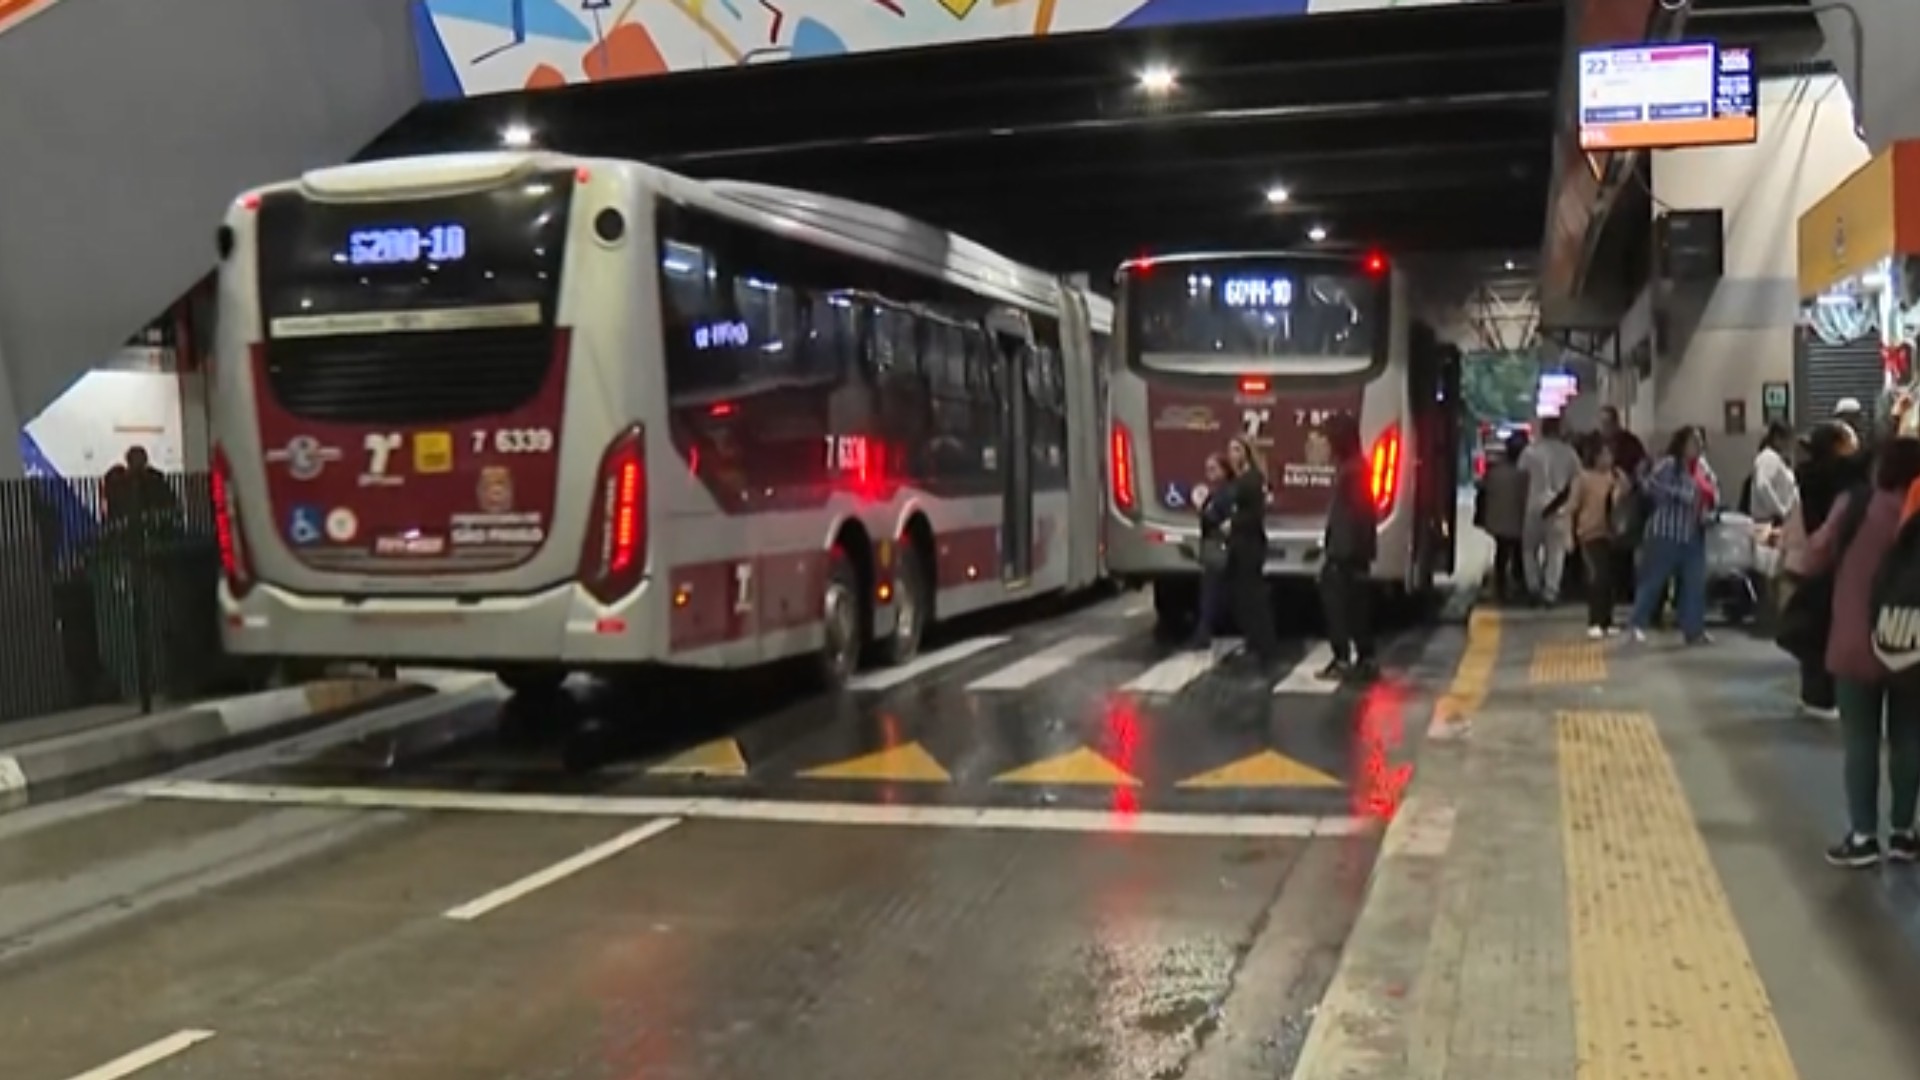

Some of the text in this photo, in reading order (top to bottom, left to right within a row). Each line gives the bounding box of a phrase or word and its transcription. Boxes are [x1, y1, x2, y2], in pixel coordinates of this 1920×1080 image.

[1585, 59, 1608, 75] 22
[471, 428, 553, 453] 7 6339
